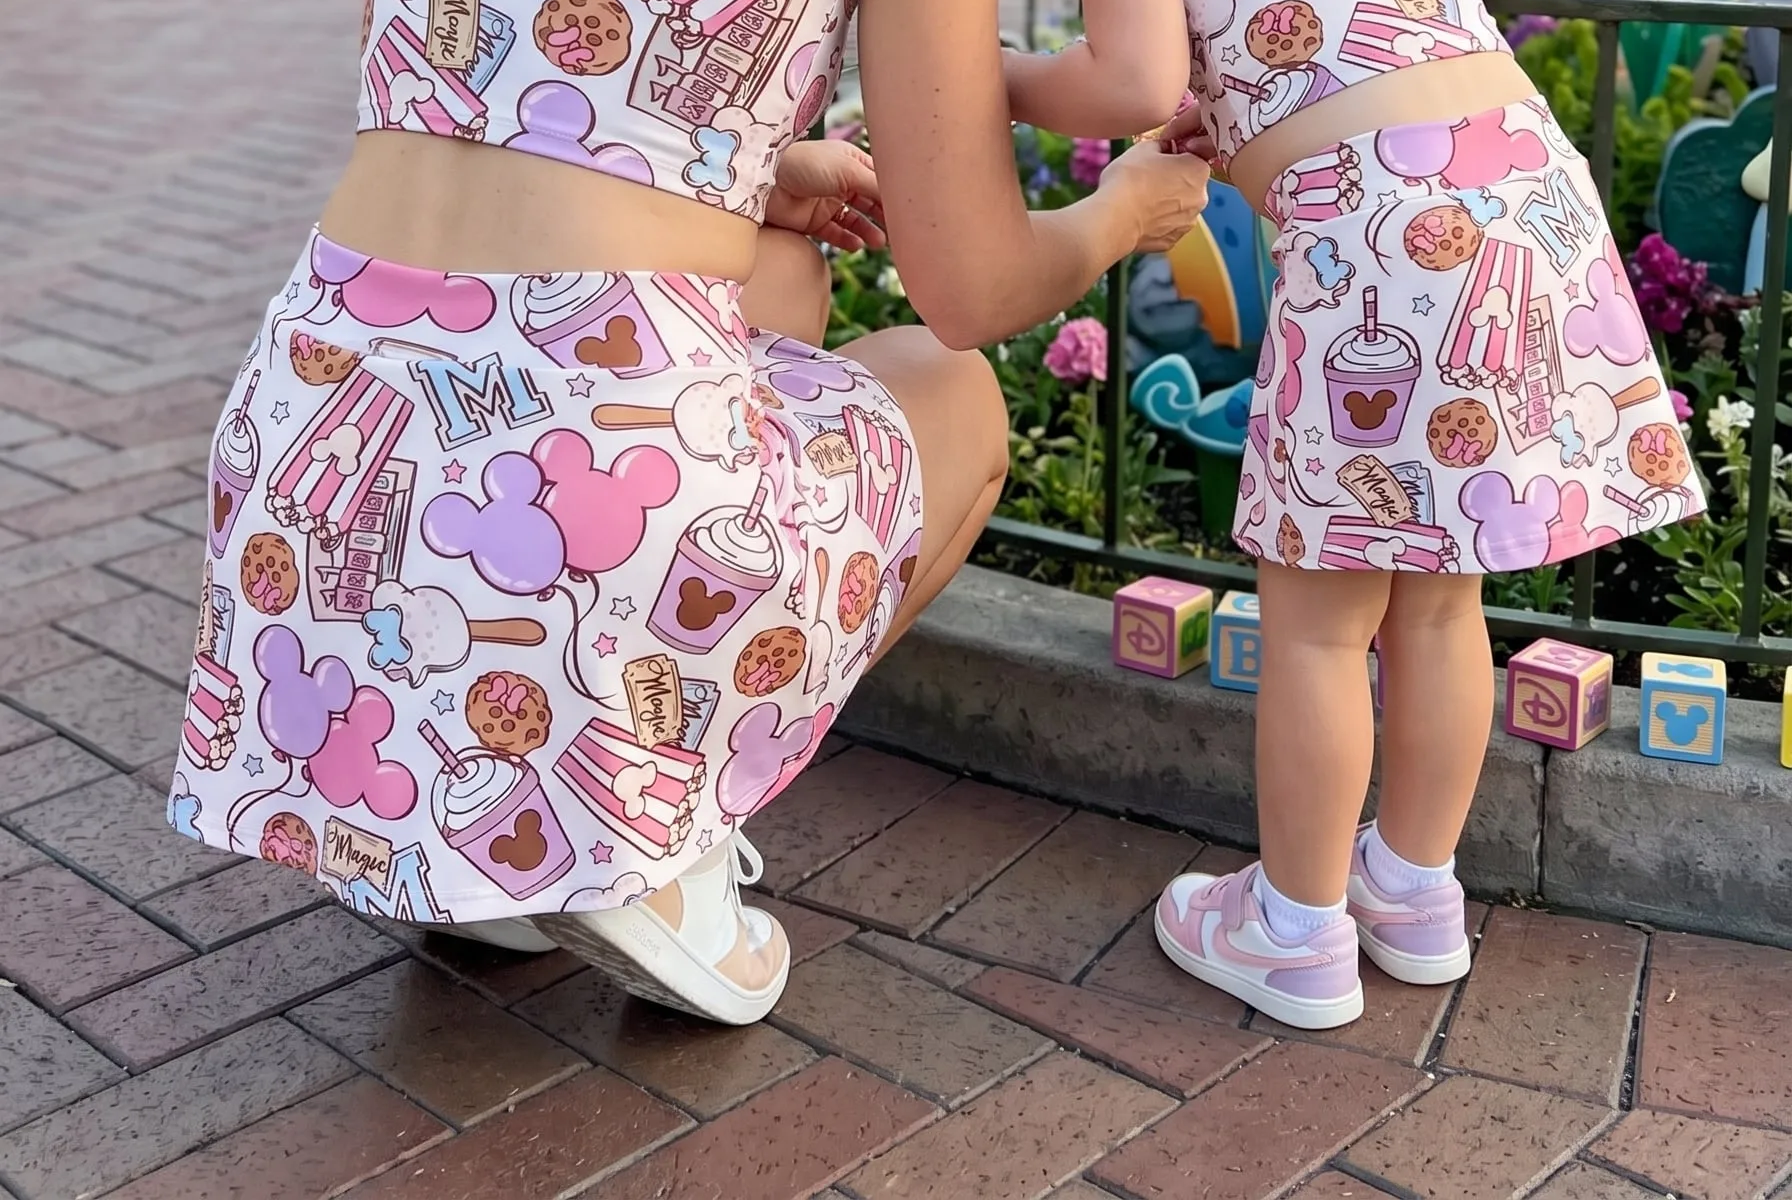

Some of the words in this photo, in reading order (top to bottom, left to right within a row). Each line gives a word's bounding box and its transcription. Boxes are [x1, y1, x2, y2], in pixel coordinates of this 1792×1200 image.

[1513, 167, 1600, 278] M
[406, 351, 555, 453] M
[1350, 460, 1400, 520] Magic
[1227, 630, 1262, 677] B
[634, 659, 672, 740] Magic
[326, 825, 387, 877] Magic
